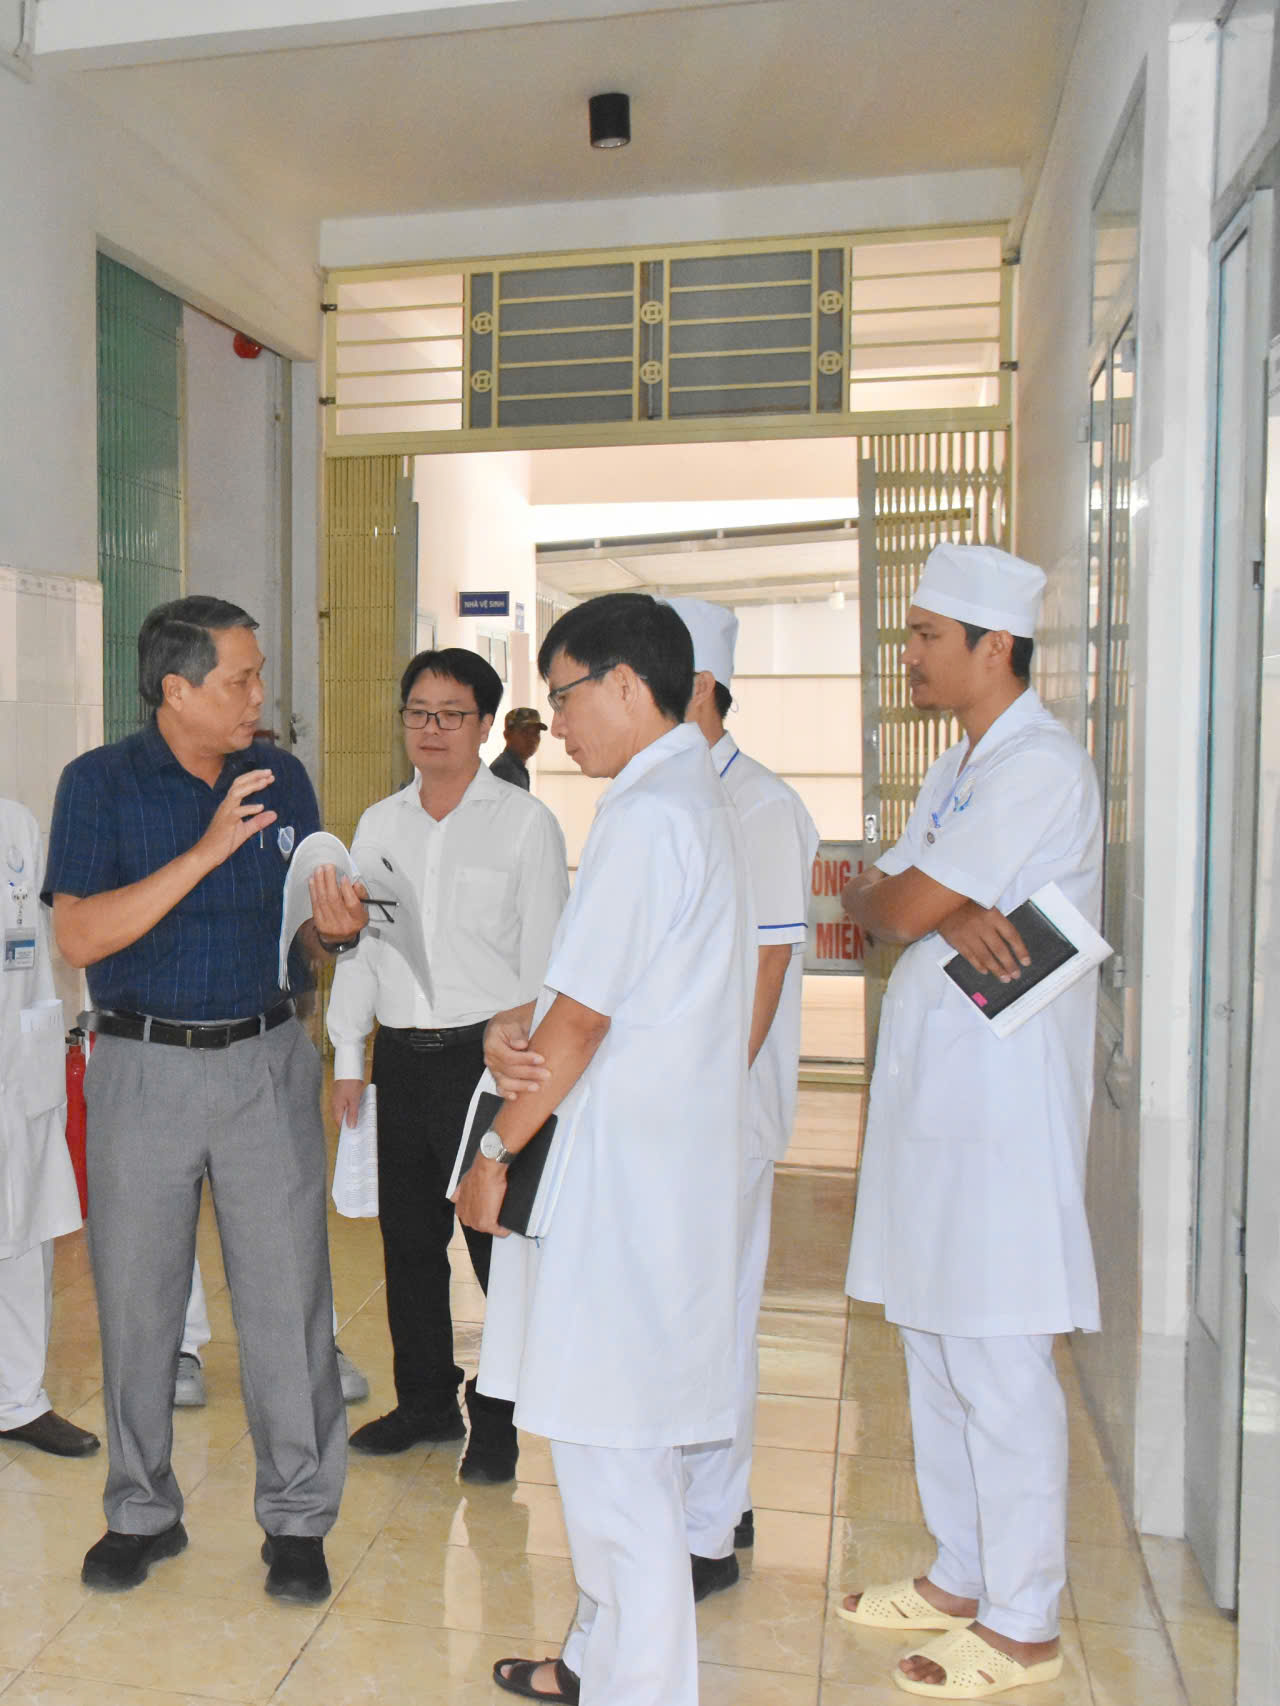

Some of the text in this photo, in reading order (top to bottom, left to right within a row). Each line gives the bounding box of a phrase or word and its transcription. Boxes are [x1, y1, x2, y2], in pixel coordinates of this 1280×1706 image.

[464, 599, 505, 609] NHÀ VỆ SINH
